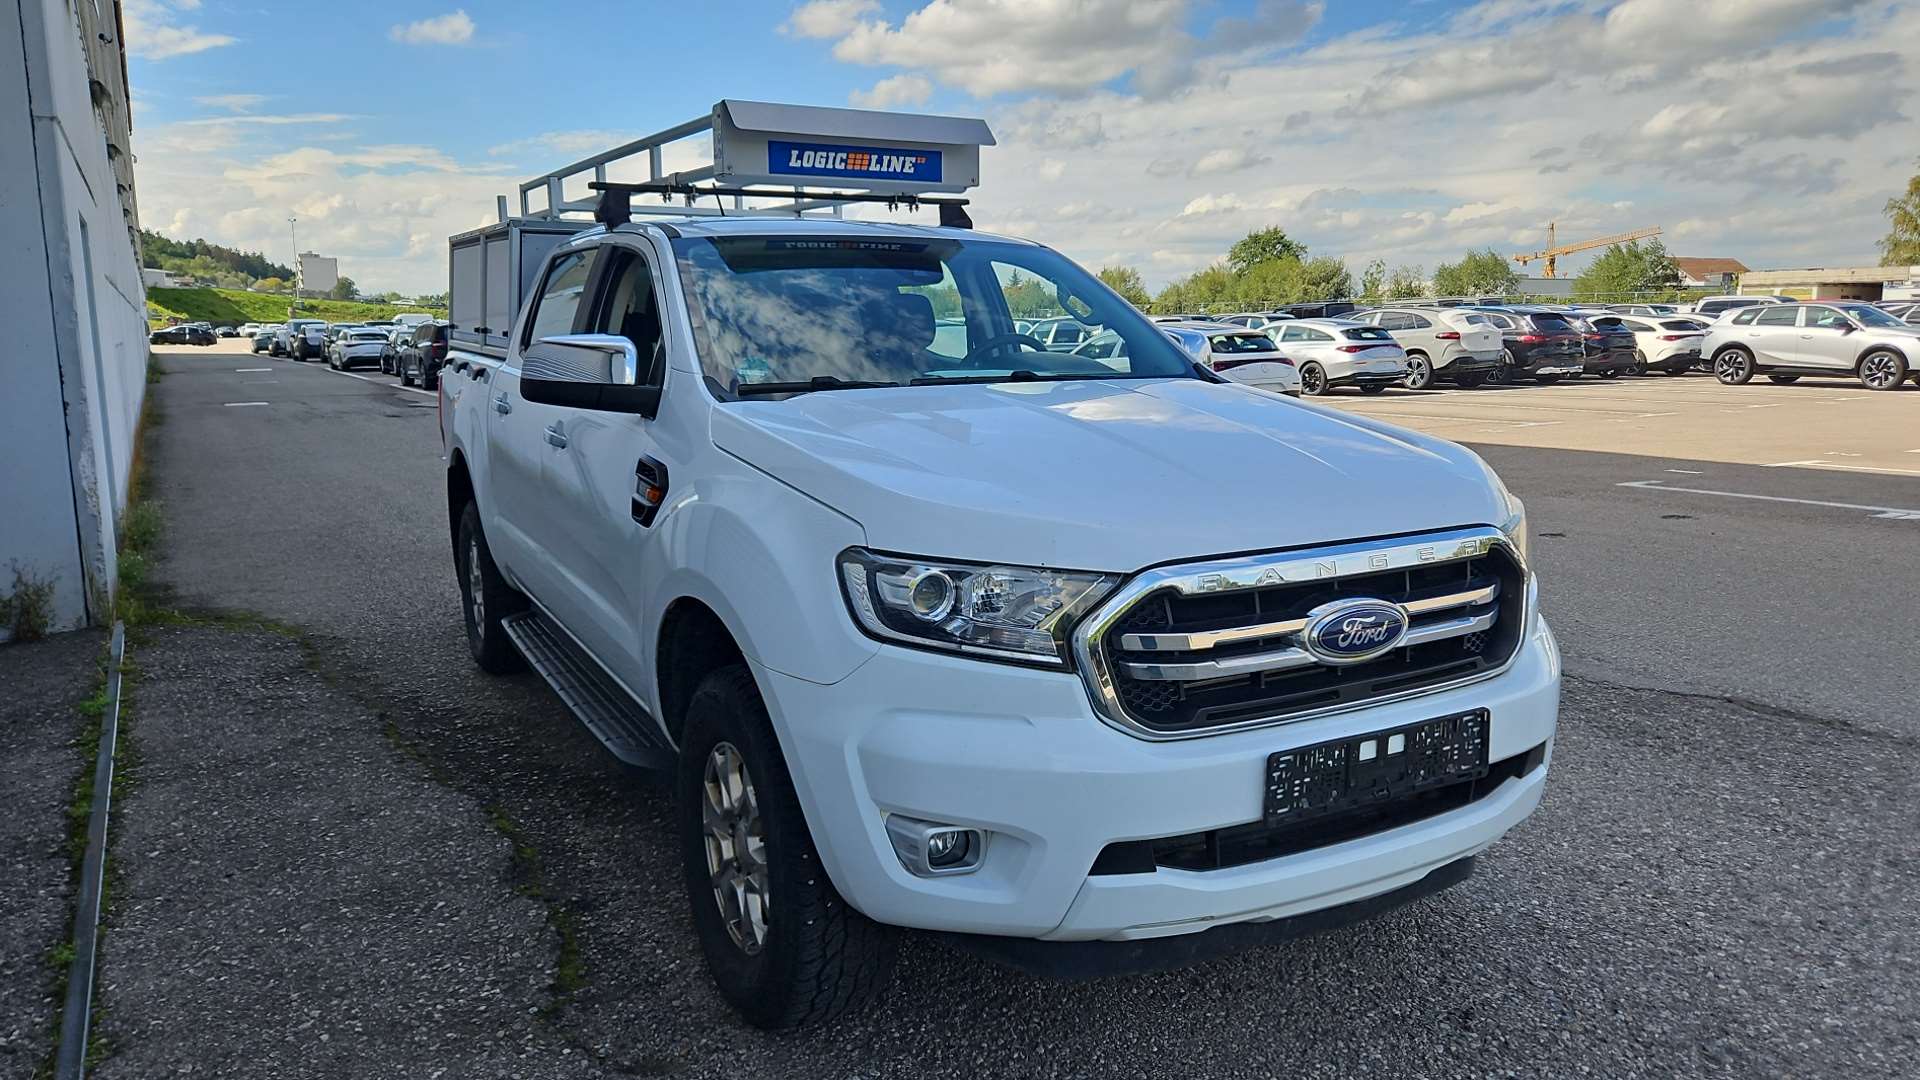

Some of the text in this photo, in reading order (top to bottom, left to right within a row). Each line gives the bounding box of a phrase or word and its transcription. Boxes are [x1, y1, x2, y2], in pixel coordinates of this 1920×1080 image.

[789, 150, 847, 169] LOGIC
[868, 154, 916, 173] LINE
[1197, 540, 1477, 592] RANGER
[1338, 616, 1389, 648] Ford
